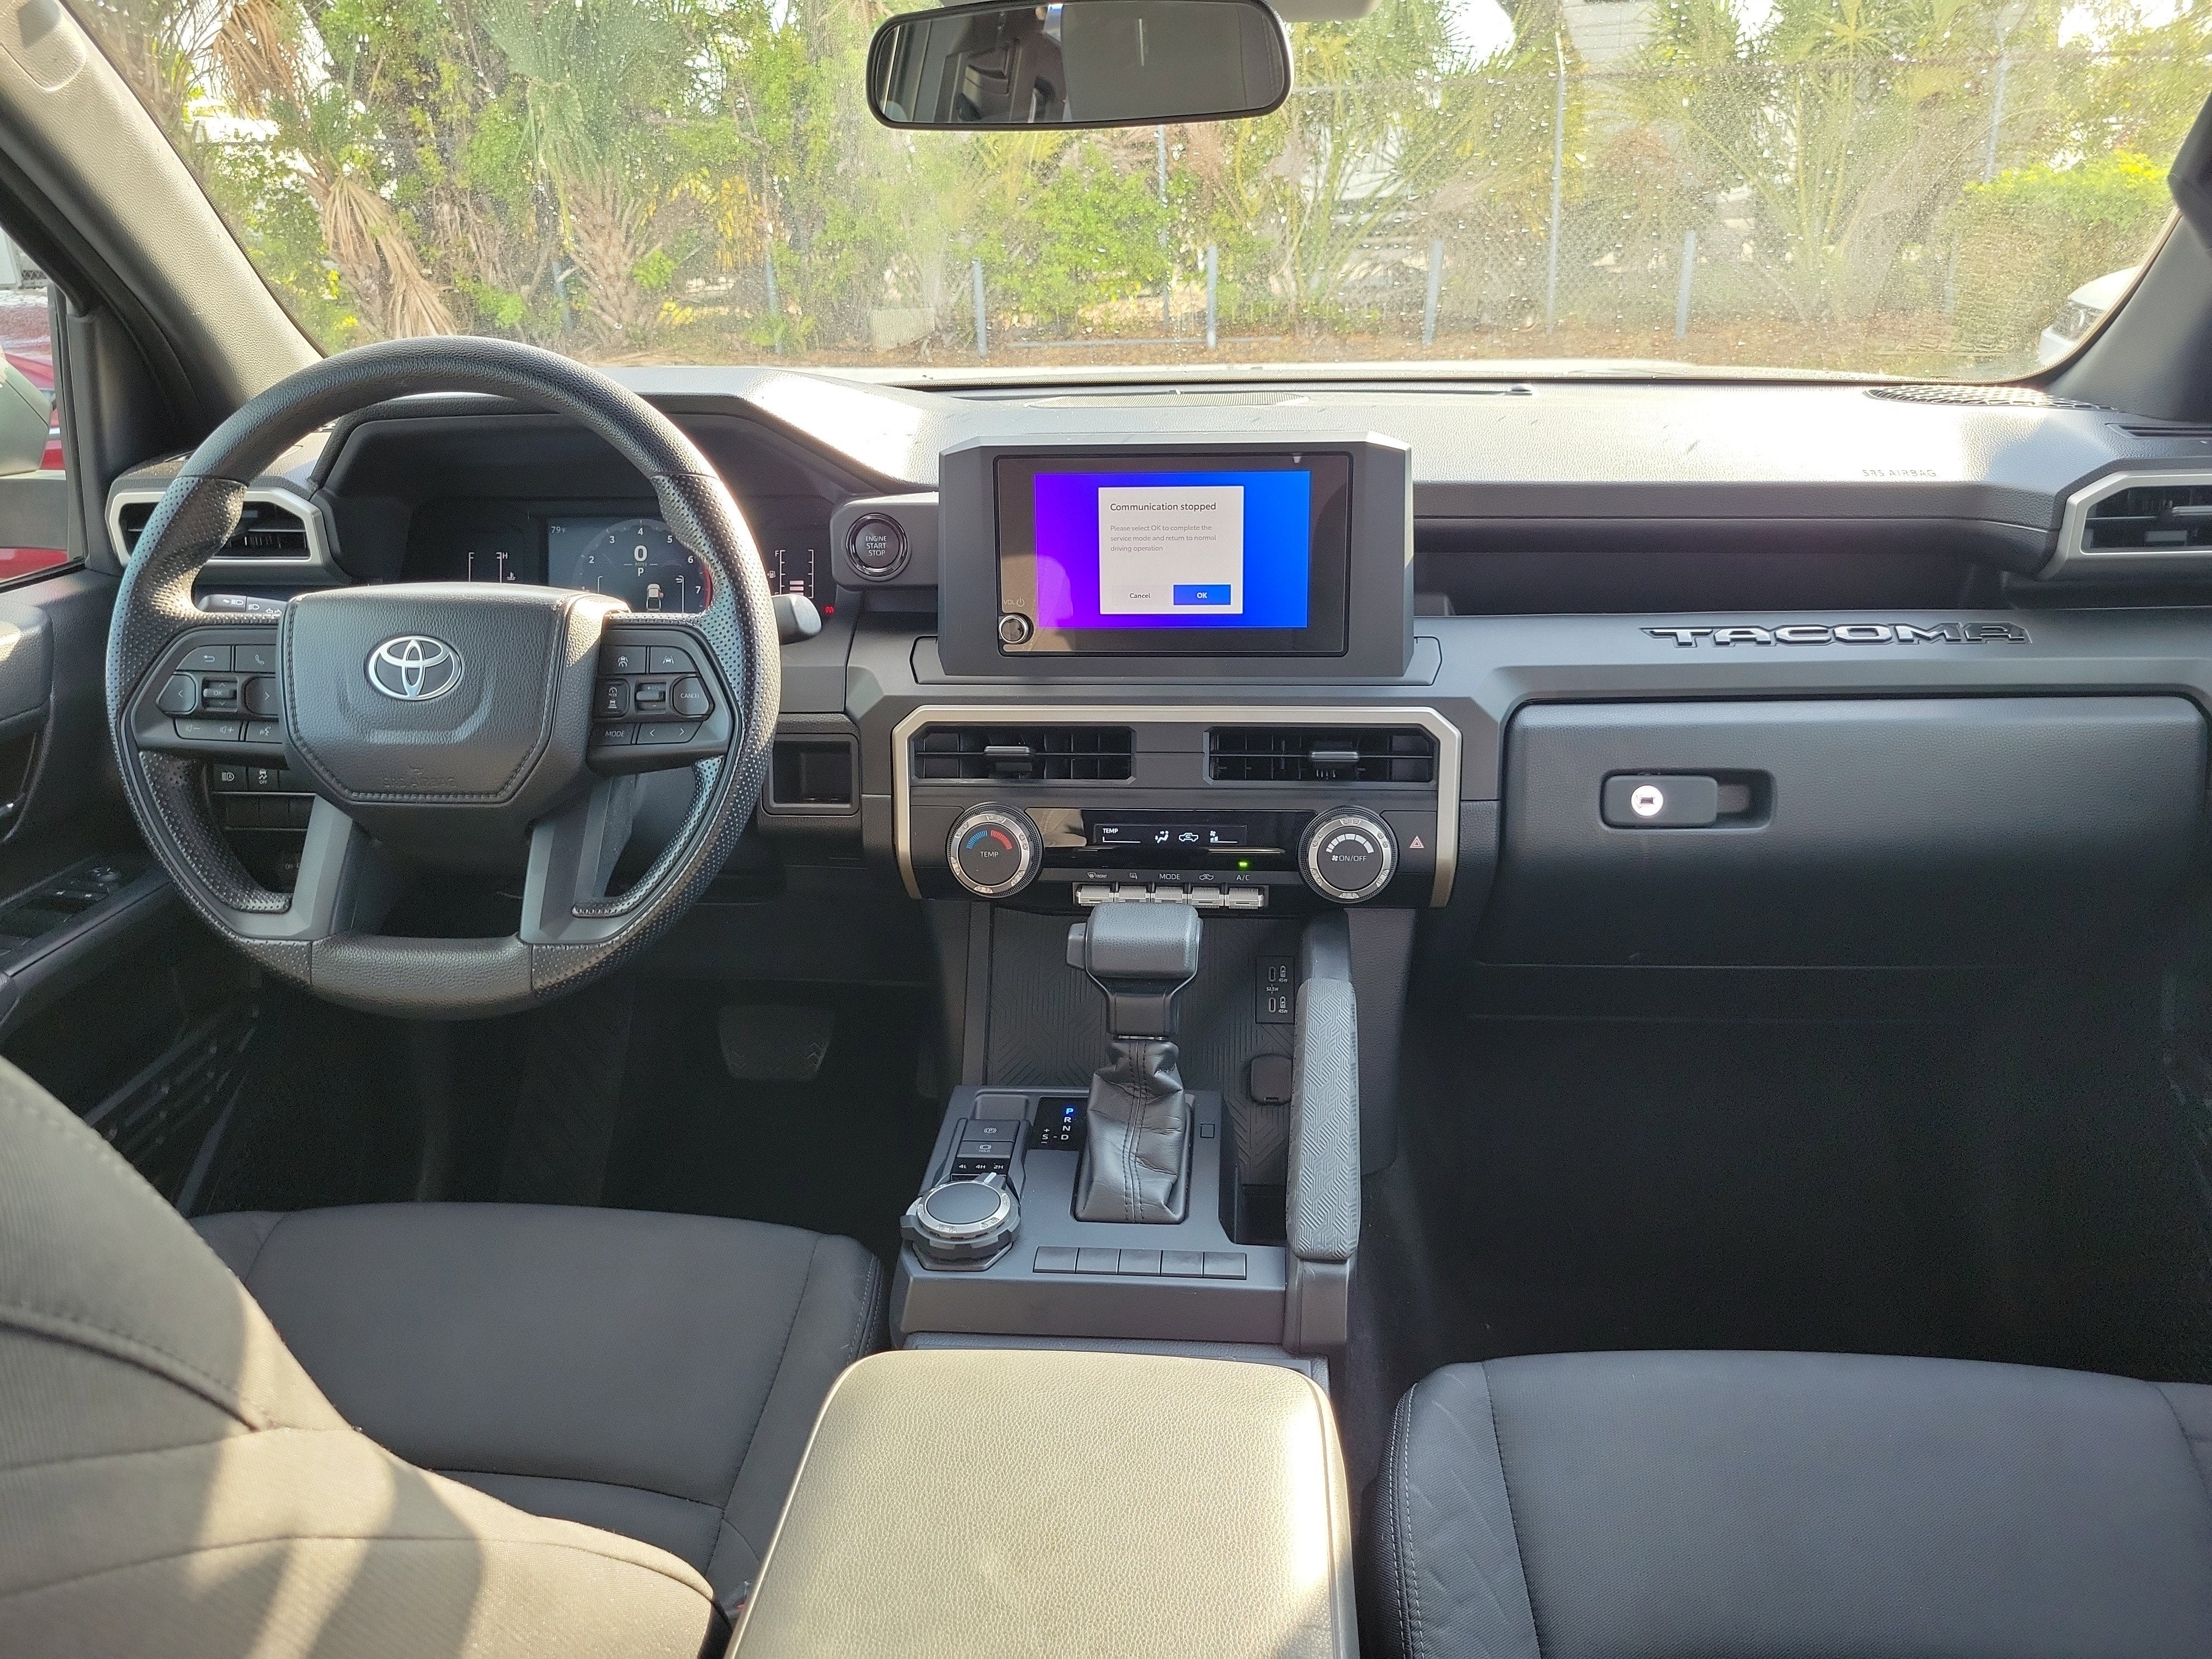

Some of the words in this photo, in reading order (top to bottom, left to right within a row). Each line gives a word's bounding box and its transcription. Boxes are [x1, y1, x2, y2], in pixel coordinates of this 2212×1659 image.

[1110, 503, 1178, 511] Communication
[1181, 502, 1216, 512] stopped
[610, 535, 615, 544] 3
[634, 545, 647, 562] 0
[589, 556, 595, 564] 2
[638, 568, 644, 576] P
[1641, 622, 2032, 647] TACOMA
